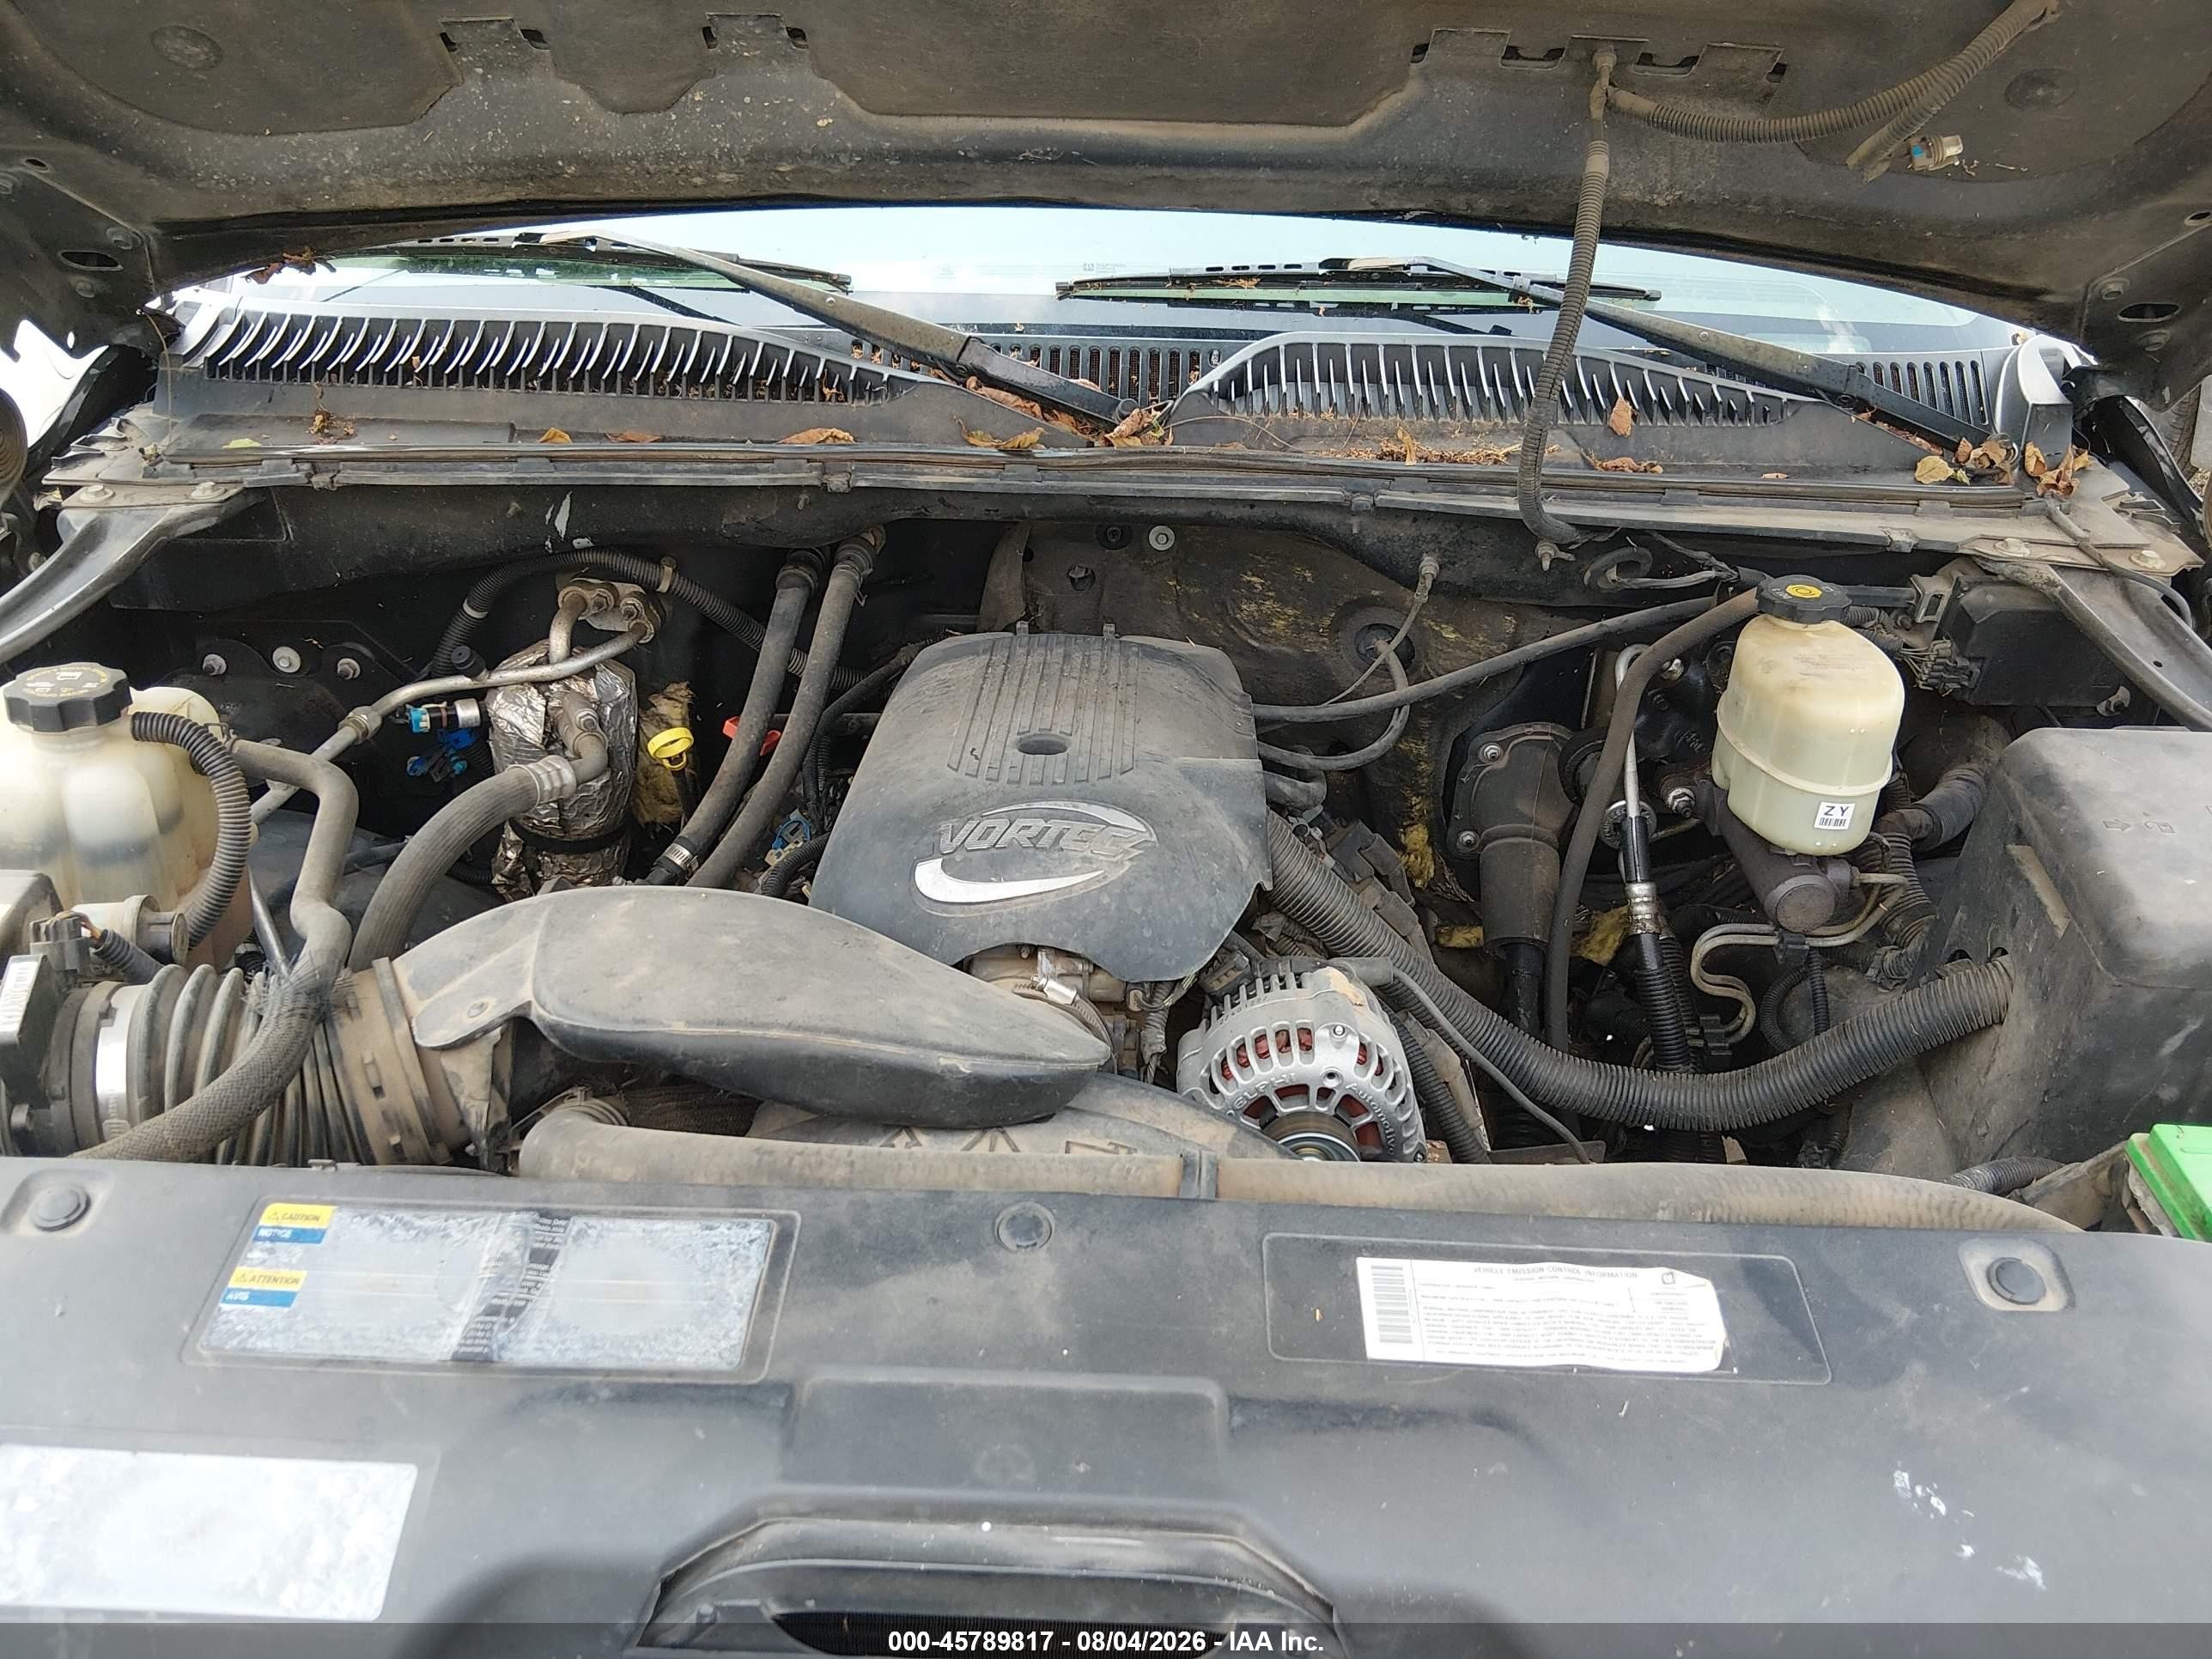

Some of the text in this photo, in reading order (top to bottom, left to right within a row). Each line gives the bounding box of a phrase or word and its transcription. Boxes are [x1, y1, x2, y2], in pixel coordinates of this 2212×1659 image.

[939, 817, 1144, 860] VORTEC
[1345, 1083, 1396, 1155] Automotive
[281, 1212, 321, 1222] CAUTION
[258, 1228, 293, 1238] NOTICE
[1507, 1266, 1545, 1274] EMISSION
[1547, 1266, 1582, 1275] CONTROL
[1584, 1269, 1638, 1279] INFORMATION
[250, 1274, 301, 1285] ATTENTION
[225, 1291, 250, 1301] AVIS
